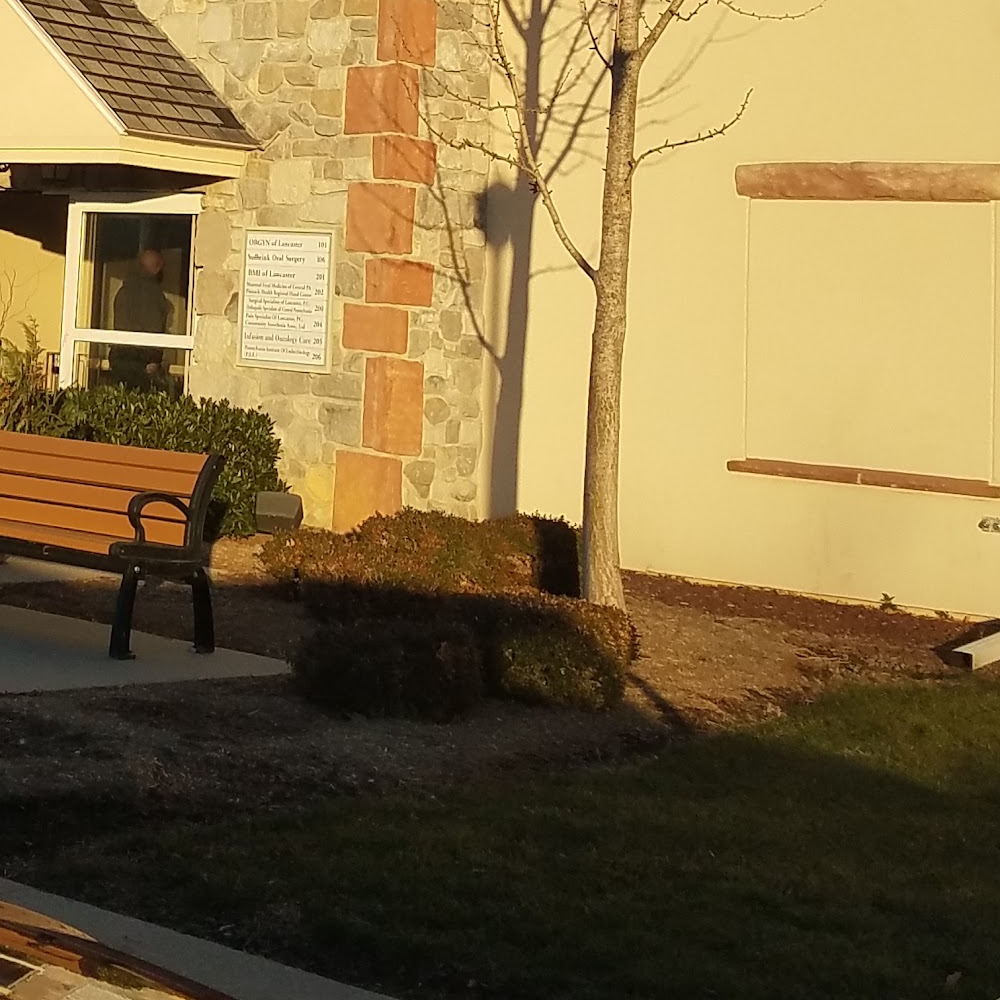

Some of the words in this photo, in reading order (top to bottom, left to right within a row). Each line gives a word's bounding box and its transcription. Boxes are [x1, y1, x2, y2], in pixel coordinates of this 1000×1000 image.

[278, 240, 303, 248] Lancaster
[285, 255, 305, 264] Surgery
[274, 335, 298, 344] Oncology
